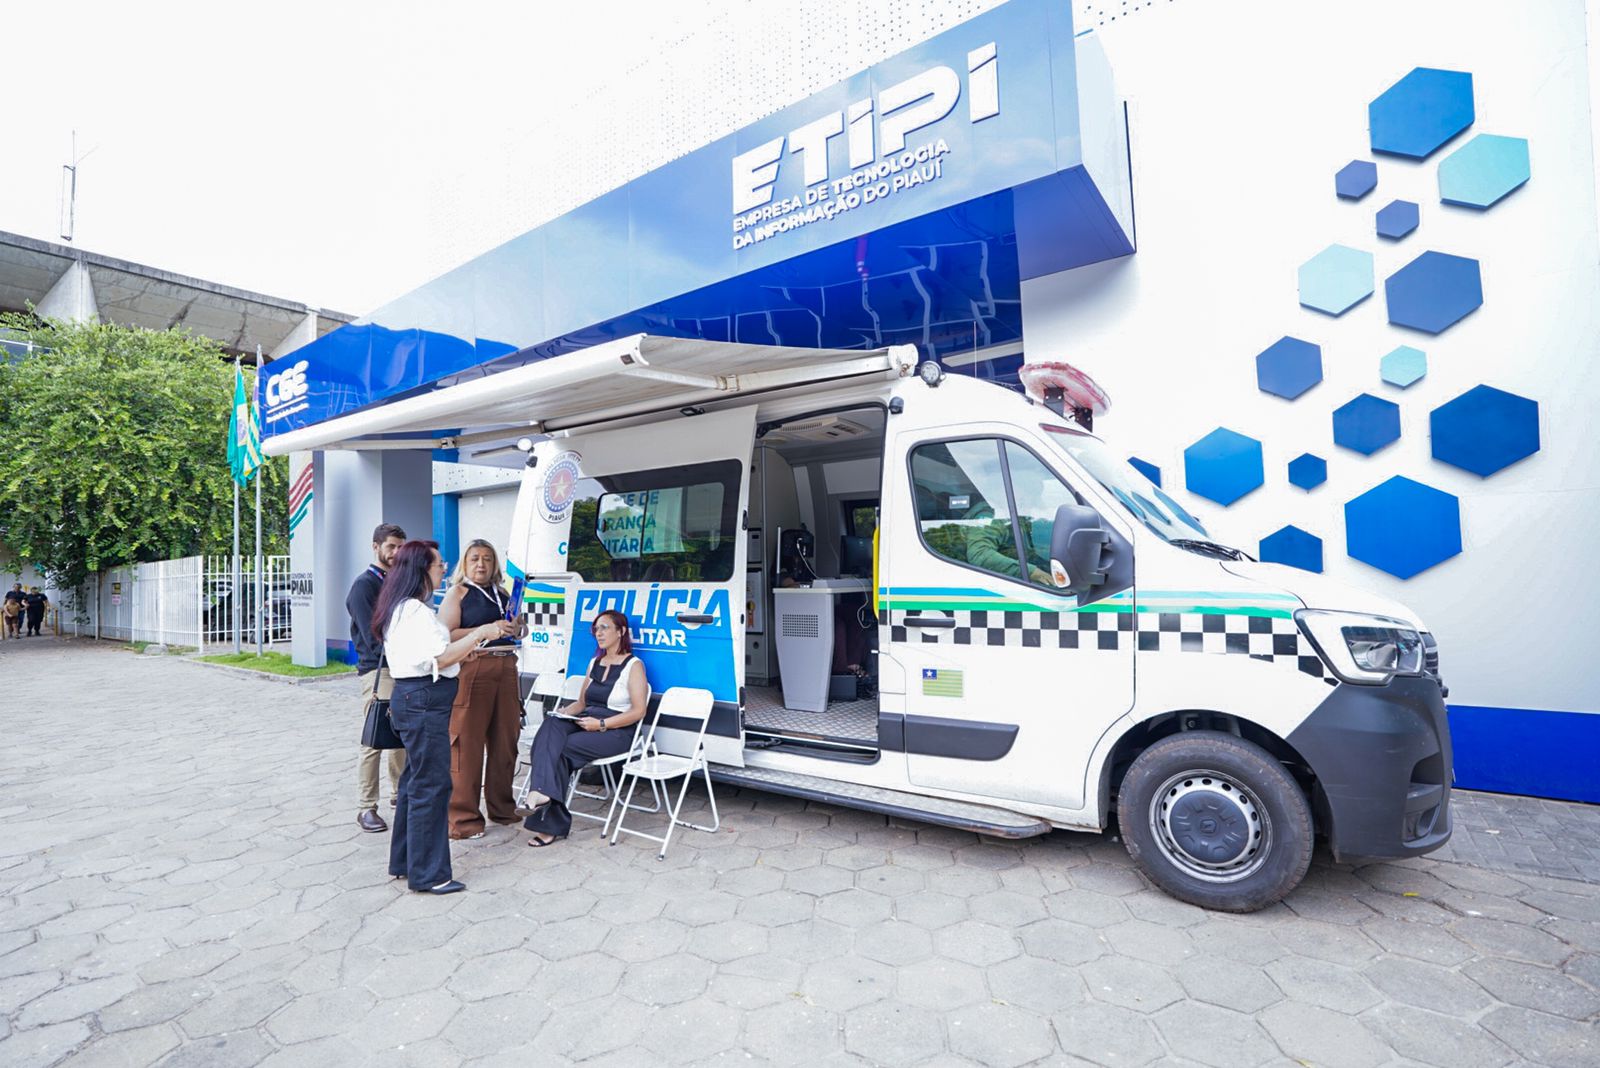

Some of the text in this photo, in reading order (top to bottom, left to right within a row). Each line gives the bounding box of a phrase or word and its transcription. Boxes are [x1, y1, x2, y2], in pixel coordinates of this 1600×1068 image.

[733, 139, 950, 232] EMPRESA DE TECNOLOGIA
[733, 156, 943, 250] DA INFORMAÇÃO DO PIAUÍ
[531, 632, 549, 643] 190
[629, 627, 688, 648] LITAR
